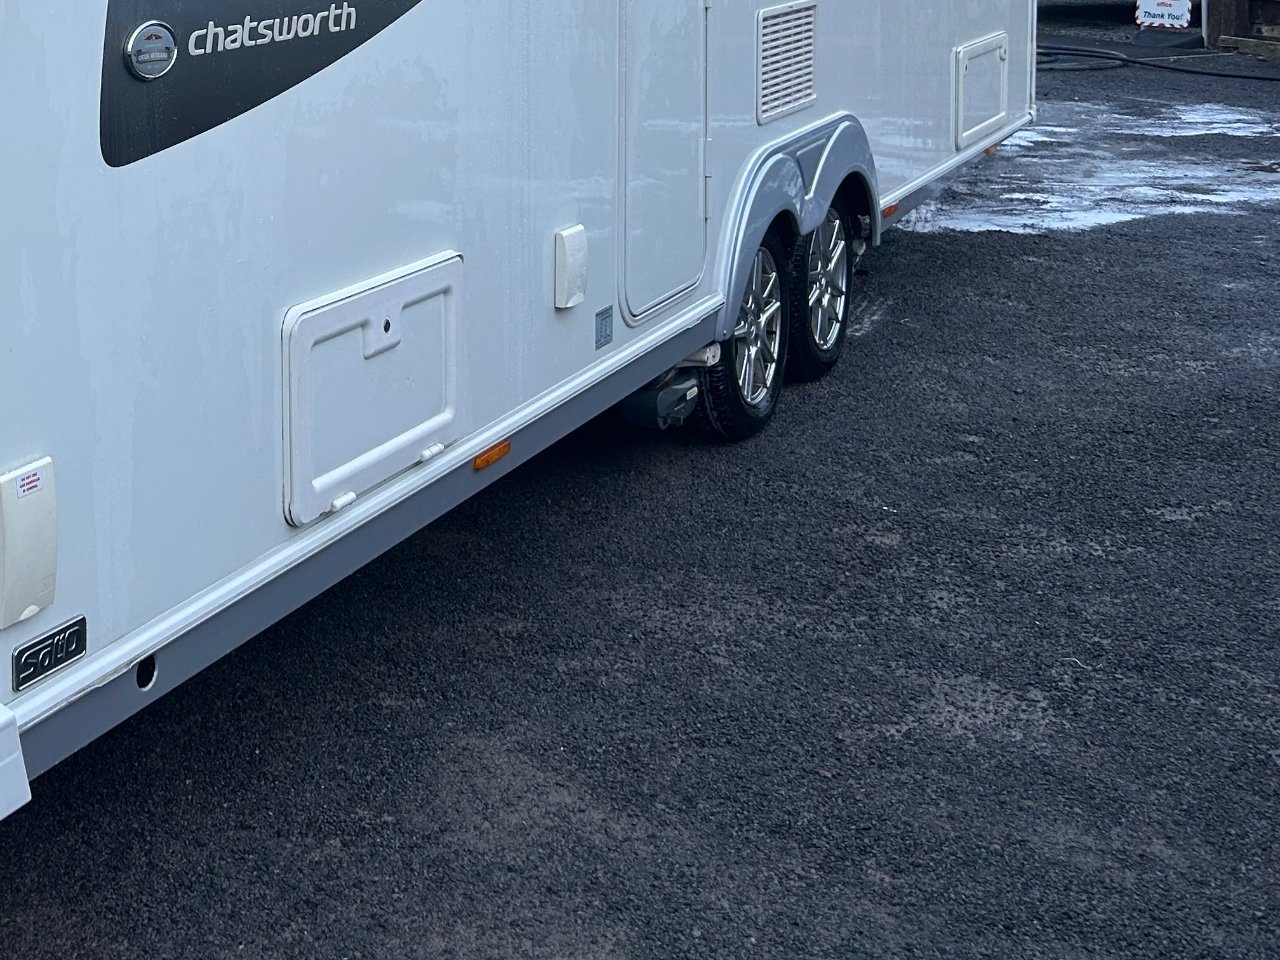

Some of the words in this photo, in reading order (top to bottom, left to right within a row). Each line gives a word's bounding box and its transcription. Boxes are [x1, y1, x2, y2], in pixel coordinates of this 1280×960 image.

[187, 1, 357, 57] chatsworth
[1143, 11, 1165, 20] Thank
[1167, 12, 1184, 20] You!
